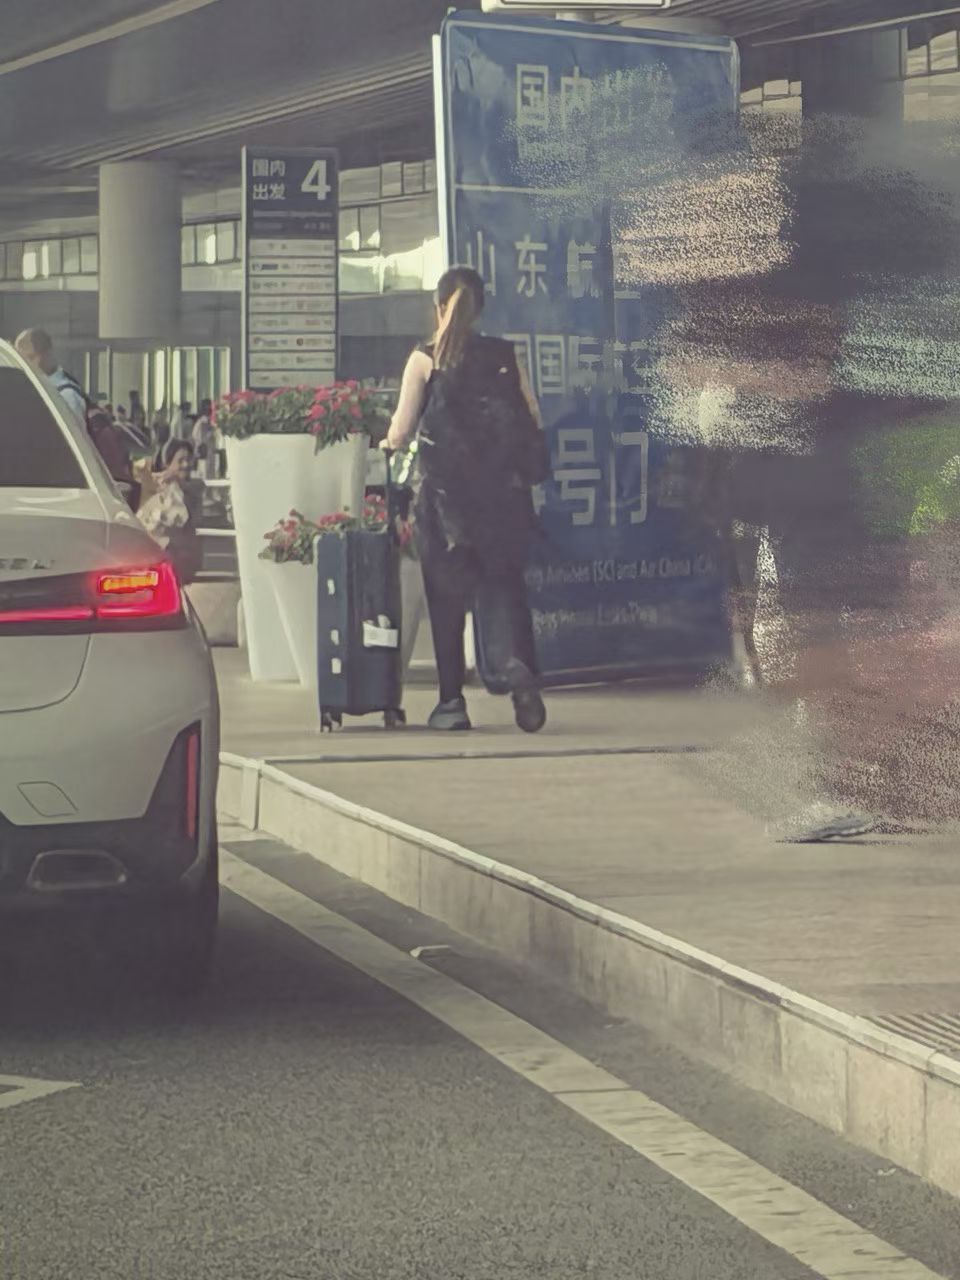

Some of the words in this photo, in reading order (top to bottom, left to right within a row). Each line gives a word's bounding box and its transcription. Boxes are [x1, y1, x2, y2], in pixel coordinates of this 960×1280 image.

[253, 159, 285, 176] 国内
[301, 160, 331, 200] 4
[253, 183, 286, 200] 出发
